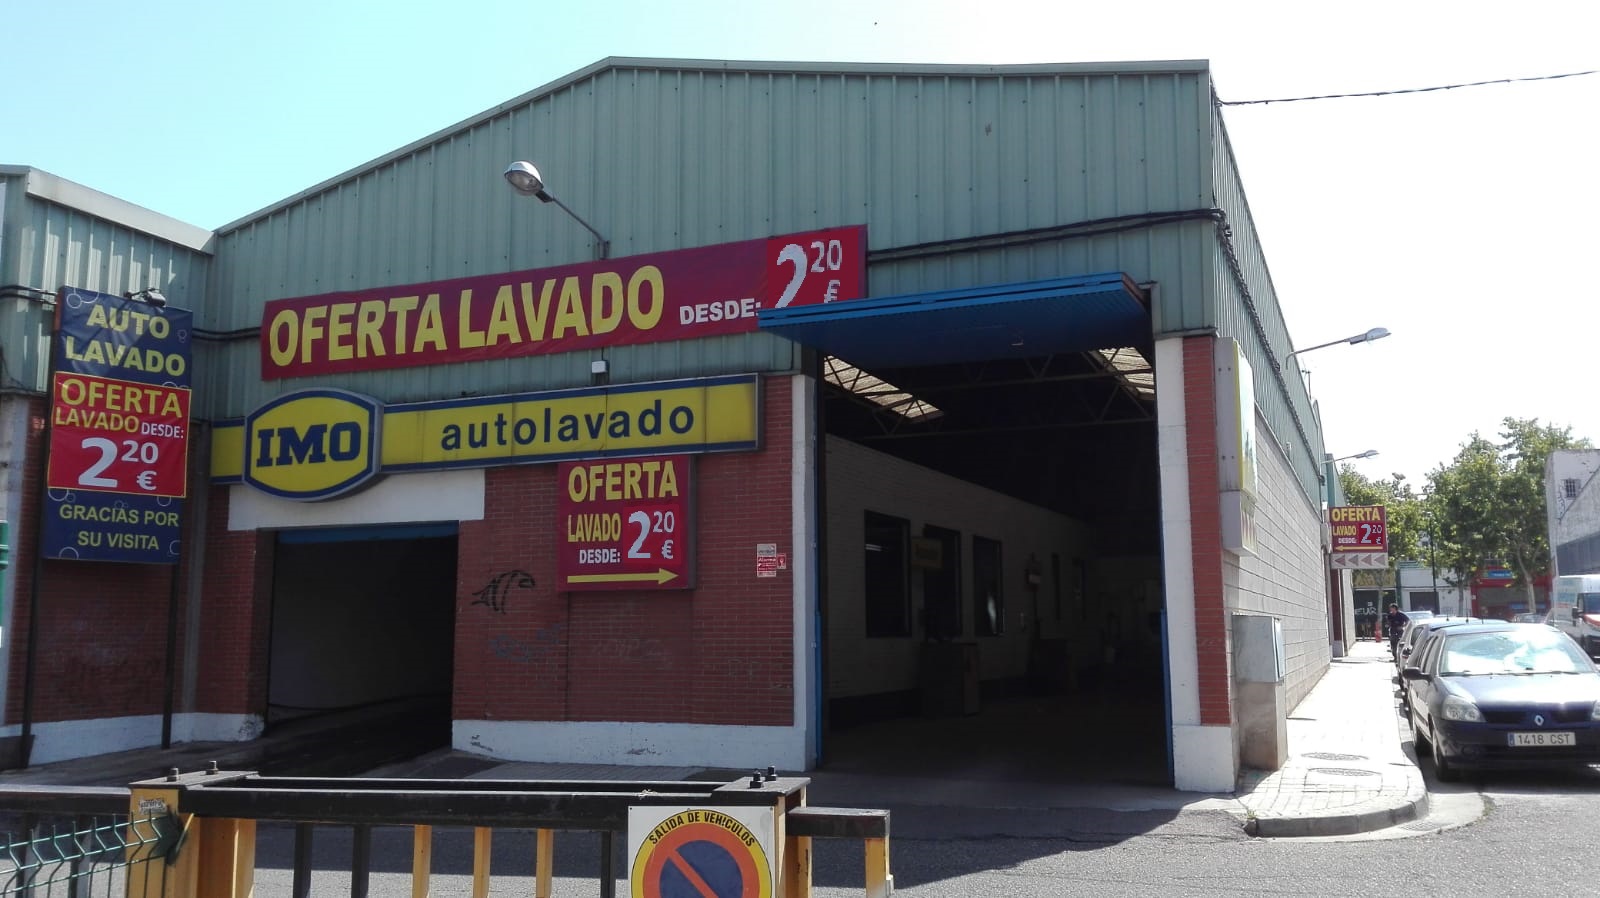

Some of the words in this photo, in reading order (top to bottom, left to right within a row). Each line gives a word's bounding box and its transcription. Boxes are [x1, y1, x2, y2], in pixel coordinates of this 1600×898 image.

[86, 304, 170, 339] AUTO
[269, 293, 448, 367] OFERTA
[459, 265, 664, 349] LAVADO
[679, 298, 762, 325] DESDE:
[65, 336, 185, 377] LAVADO
[60, 378, 182, 418] OFERTA
[55, 406, 139, 433] LAVADO
[141, 422, 184, 439] DESDE:
[441, 399, 694, 450] autolavado
[256, 421, 362, 467] IMO
[136, 470, 157, 491] €
[568, 460, 679, 502] OFERTA
[59, 504, 139, 524] GRACIAS
[144, 510, 179, 527] POR
[567, 512, 622, 542] LAVADO
[1332, 508, 1380, 521] OFERTA
[1333, 525, 1356, 536] LAVADO
[77, 531, 102, 547] SU
[107, 533, 159, 550] VISITA
[579, 548, 621, 564] DESDE:
[661, 539, 674, 559] €
[1518, 734, 1545, 745] 1418
[1551, 734, 1570, 745] CST
[649, 815, 684, 844] SALIDA
[687, 811, 700, 823] DE
